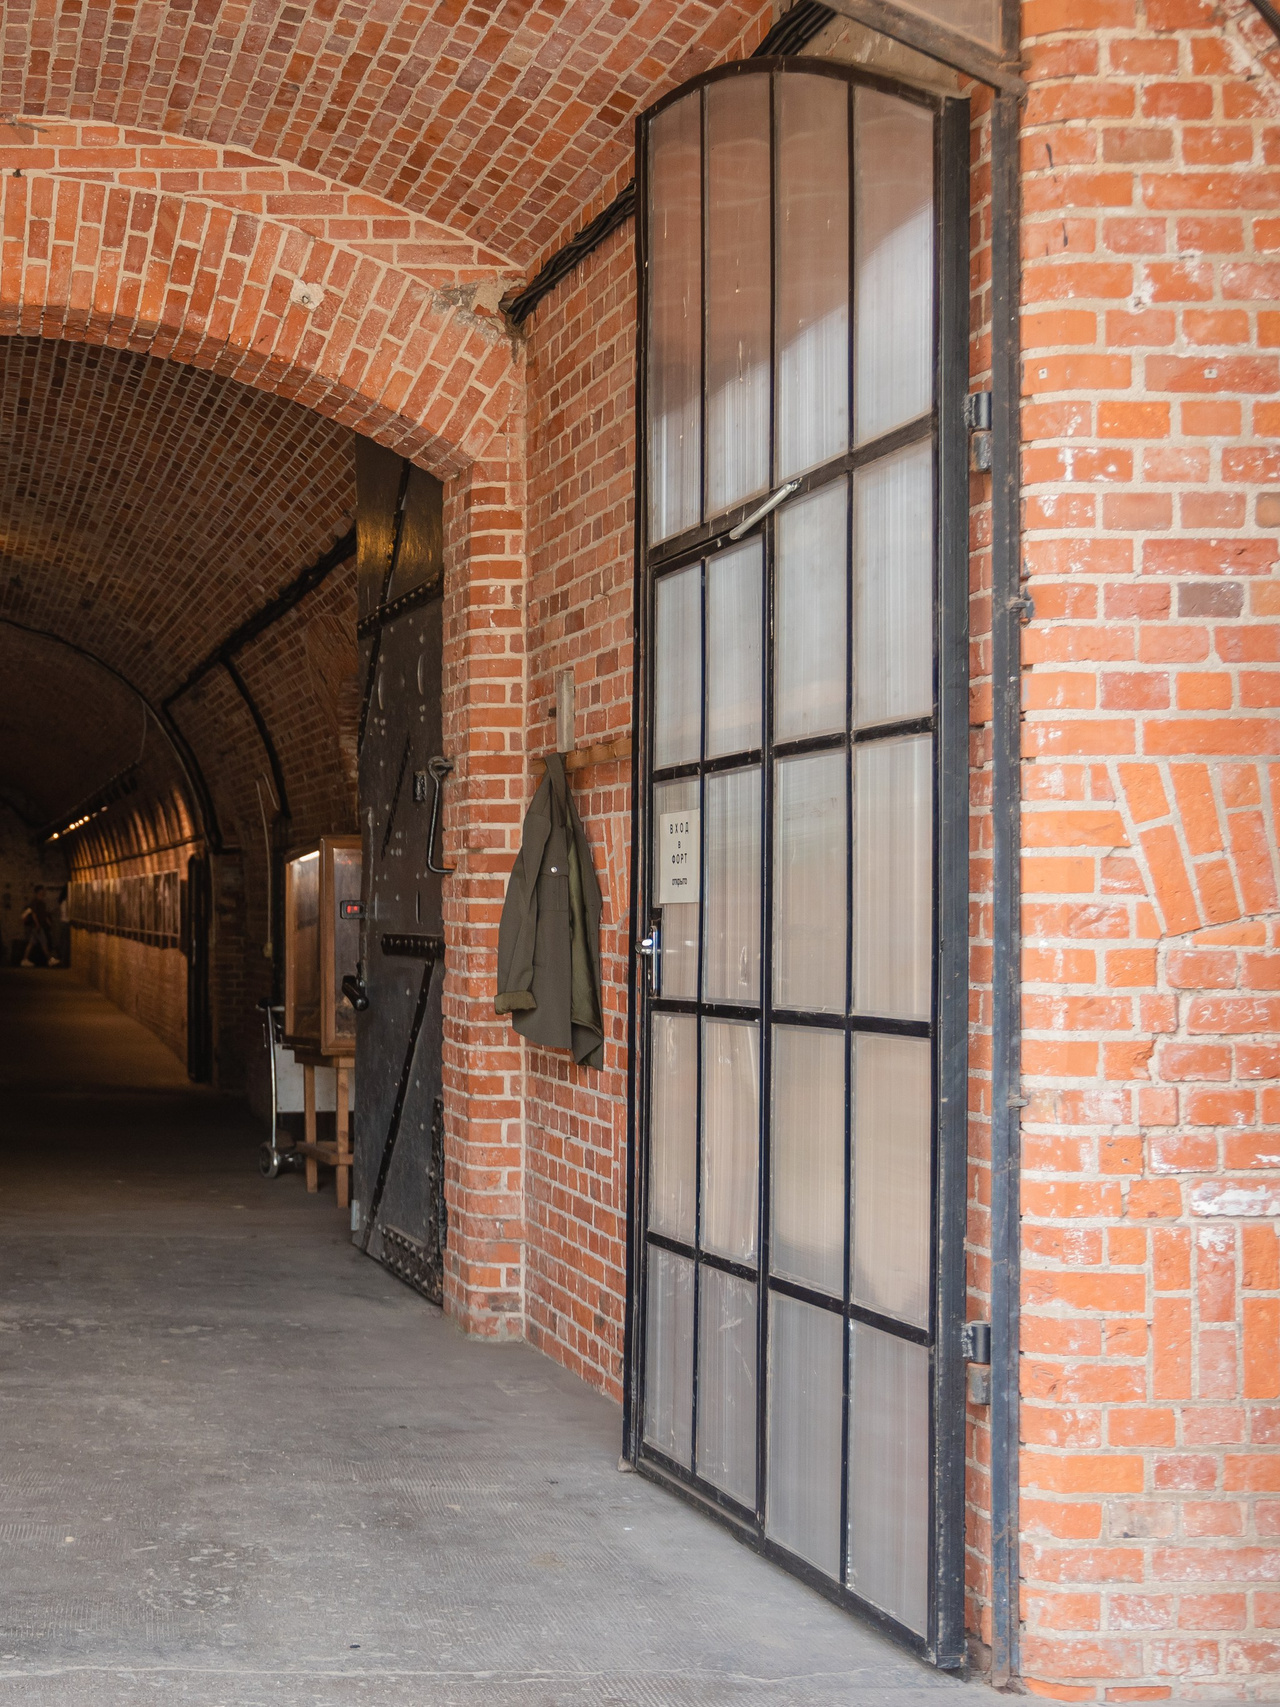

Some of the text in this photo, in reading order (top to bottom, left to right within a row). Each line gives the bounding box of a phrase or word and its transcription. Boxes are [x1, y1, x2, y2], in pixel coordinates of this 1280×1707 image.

[669, 821, 689, 834] ВХОД
[671, 852, 688, 864] ФОРТ
[671, 877, 688, 887] открыто
